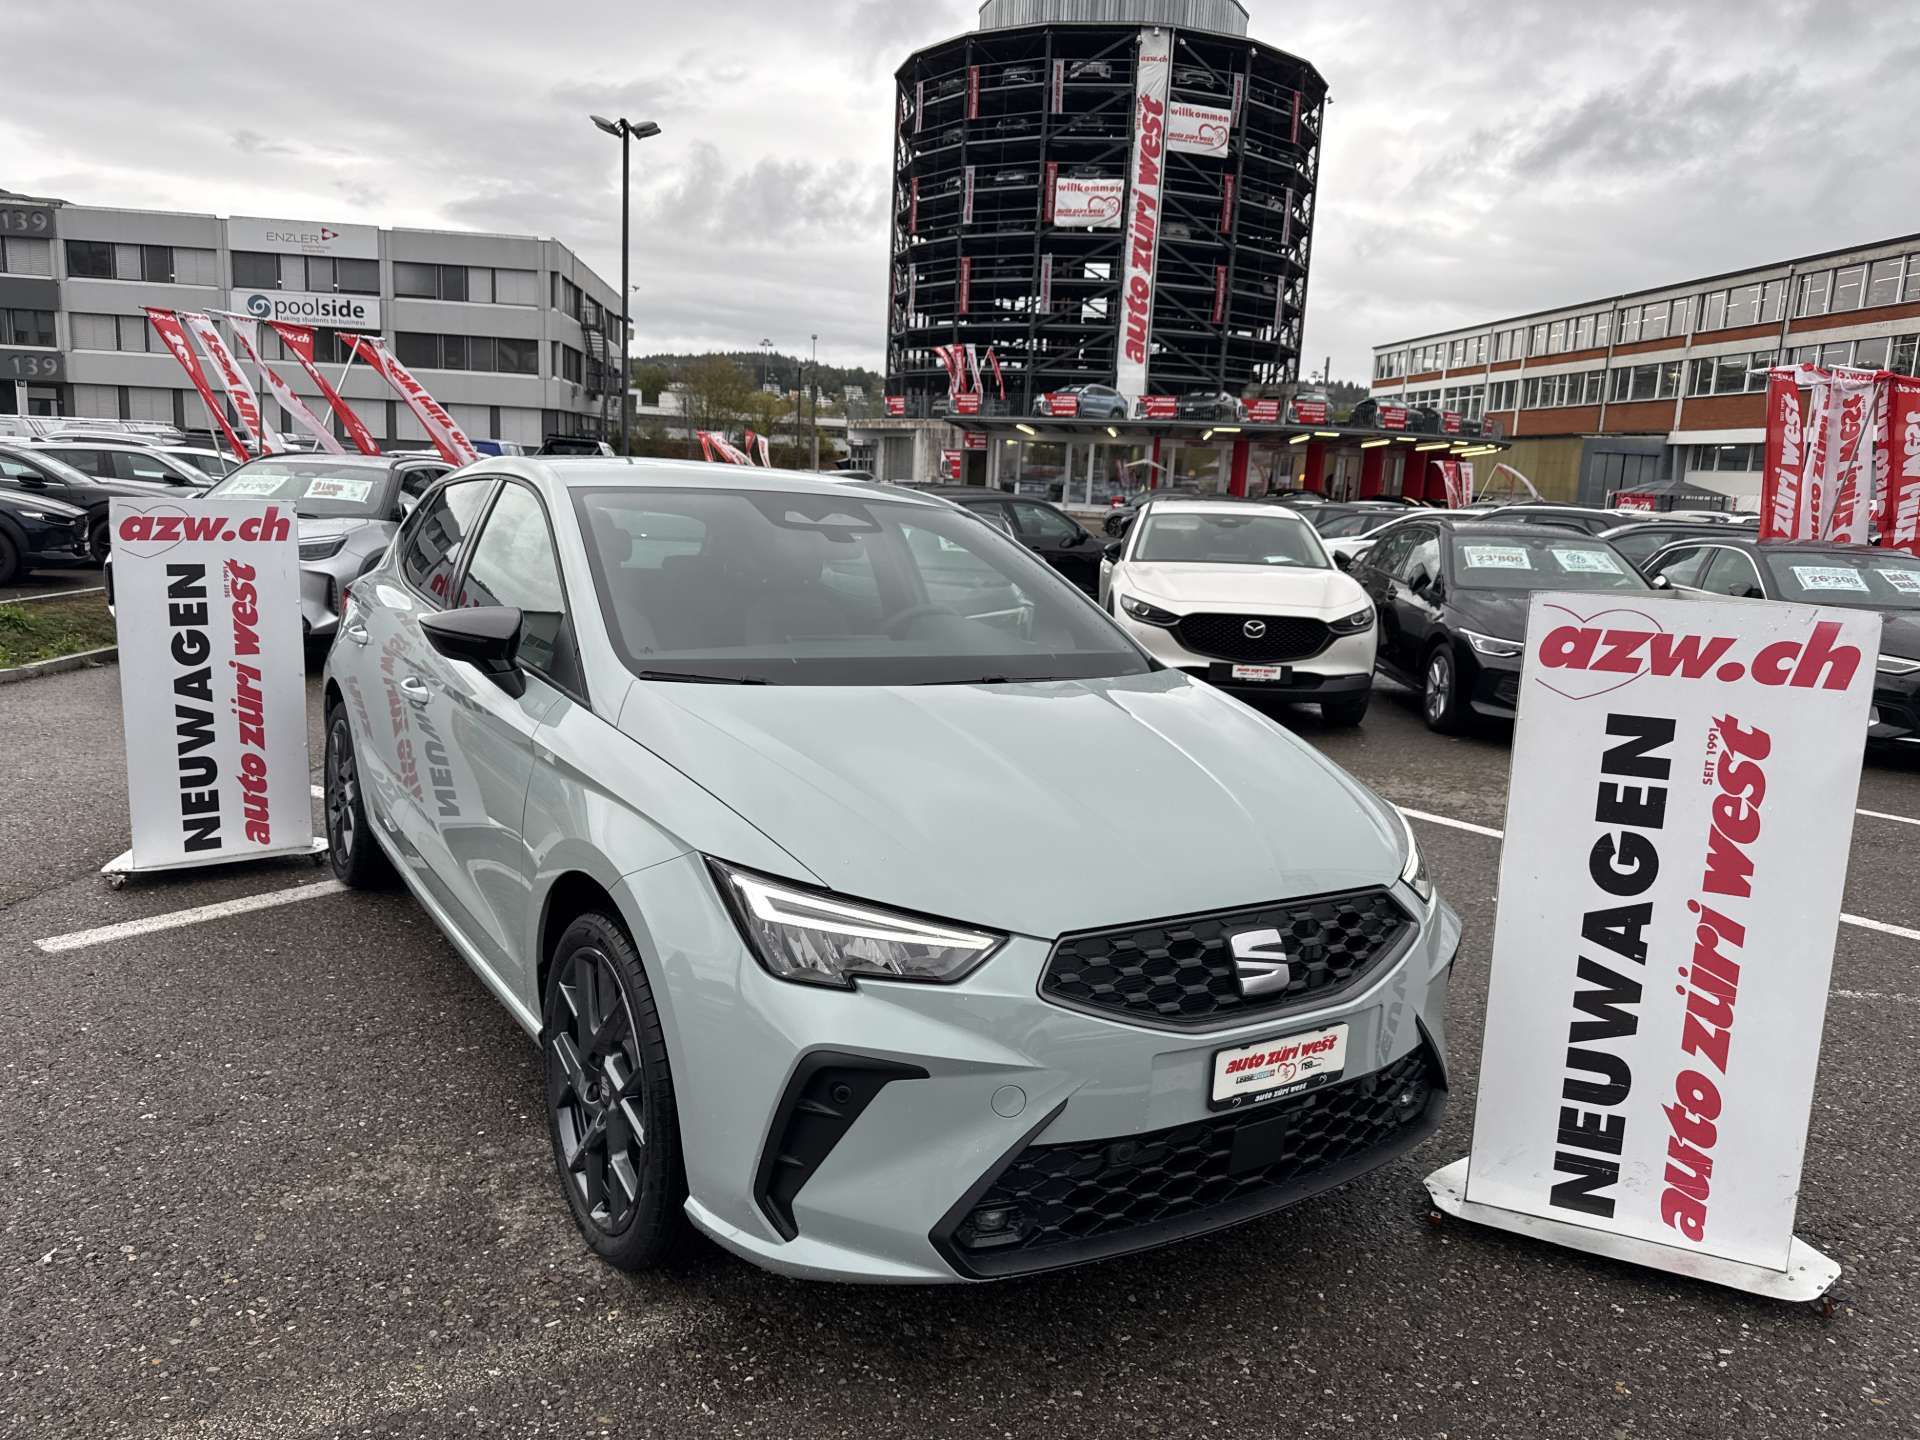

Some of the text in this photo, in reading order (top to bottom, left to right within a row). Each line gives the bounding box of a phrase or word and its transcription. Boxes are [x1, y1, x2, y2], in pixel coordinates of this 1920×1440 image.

[1170, 107, 1230, 123] willkommen
[1057, 182, 1122, 193] willkommen
[0, 210, 48, 231] 139
[265, 231, 319, 245] ENZLER
[1125, 93, 1164, 365] auto züri west
[274, 297, 365, 321] poolside
[301, 316, 329, 324] students
[338, 318, 366, 326] business
[8, 355, 58, 376] 139
[1780, 393, 1801, 466] west
[1772, 467, 1800, 538] züri
[118, 506, 291, 542] azw.ch
[224, 583, 232, 599] SEIT
[1538, 621, 1862, 691] azw.ch
[166, 563, 222, 853] NEUWAGEN
[223, 558, 270, 846] auto züri west
[1702, 727, 1720, 786] SEIT 1991
[1549, 713, 1678, 1220] NEUWAGEN
[1661, 713, 1771, 1243] auto züri west
[1225, 1034, 1338, 1075] auto züri west
[1254, 1082, 1307, 1102] auto züri west
